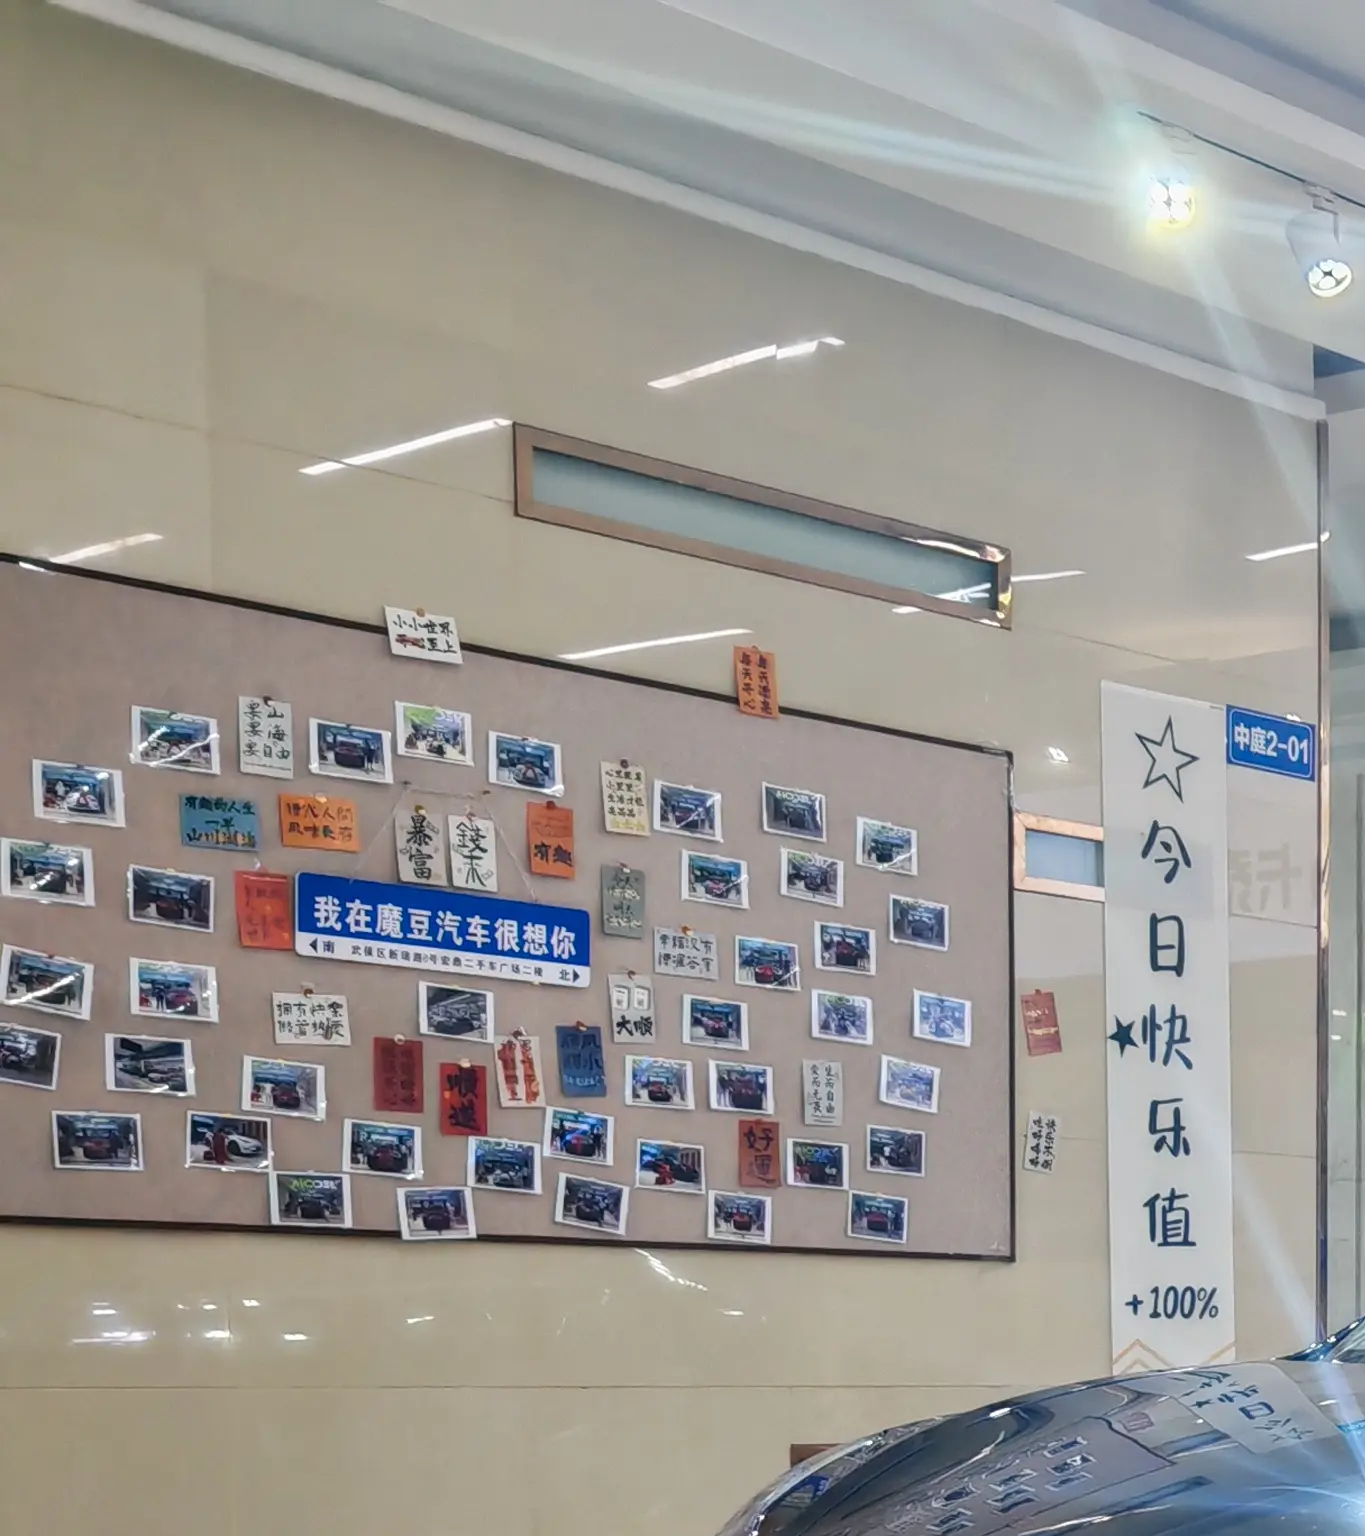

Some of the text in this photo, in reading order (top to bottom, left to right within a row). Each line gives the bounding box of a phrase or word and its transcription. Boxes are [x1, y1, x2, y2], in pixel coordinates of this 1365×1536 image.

[1233, 722, 1309, 764] 中庭2-01
[313, 895, 577, 959] 我在魔豆汽车很想你
[322, 939, 335, 955] 南
[558, 968, 571, 982] 北
[1140, 818, 1197, 1249] 今日快乐值
[1125, 1285, 1219, 1322] +100%
